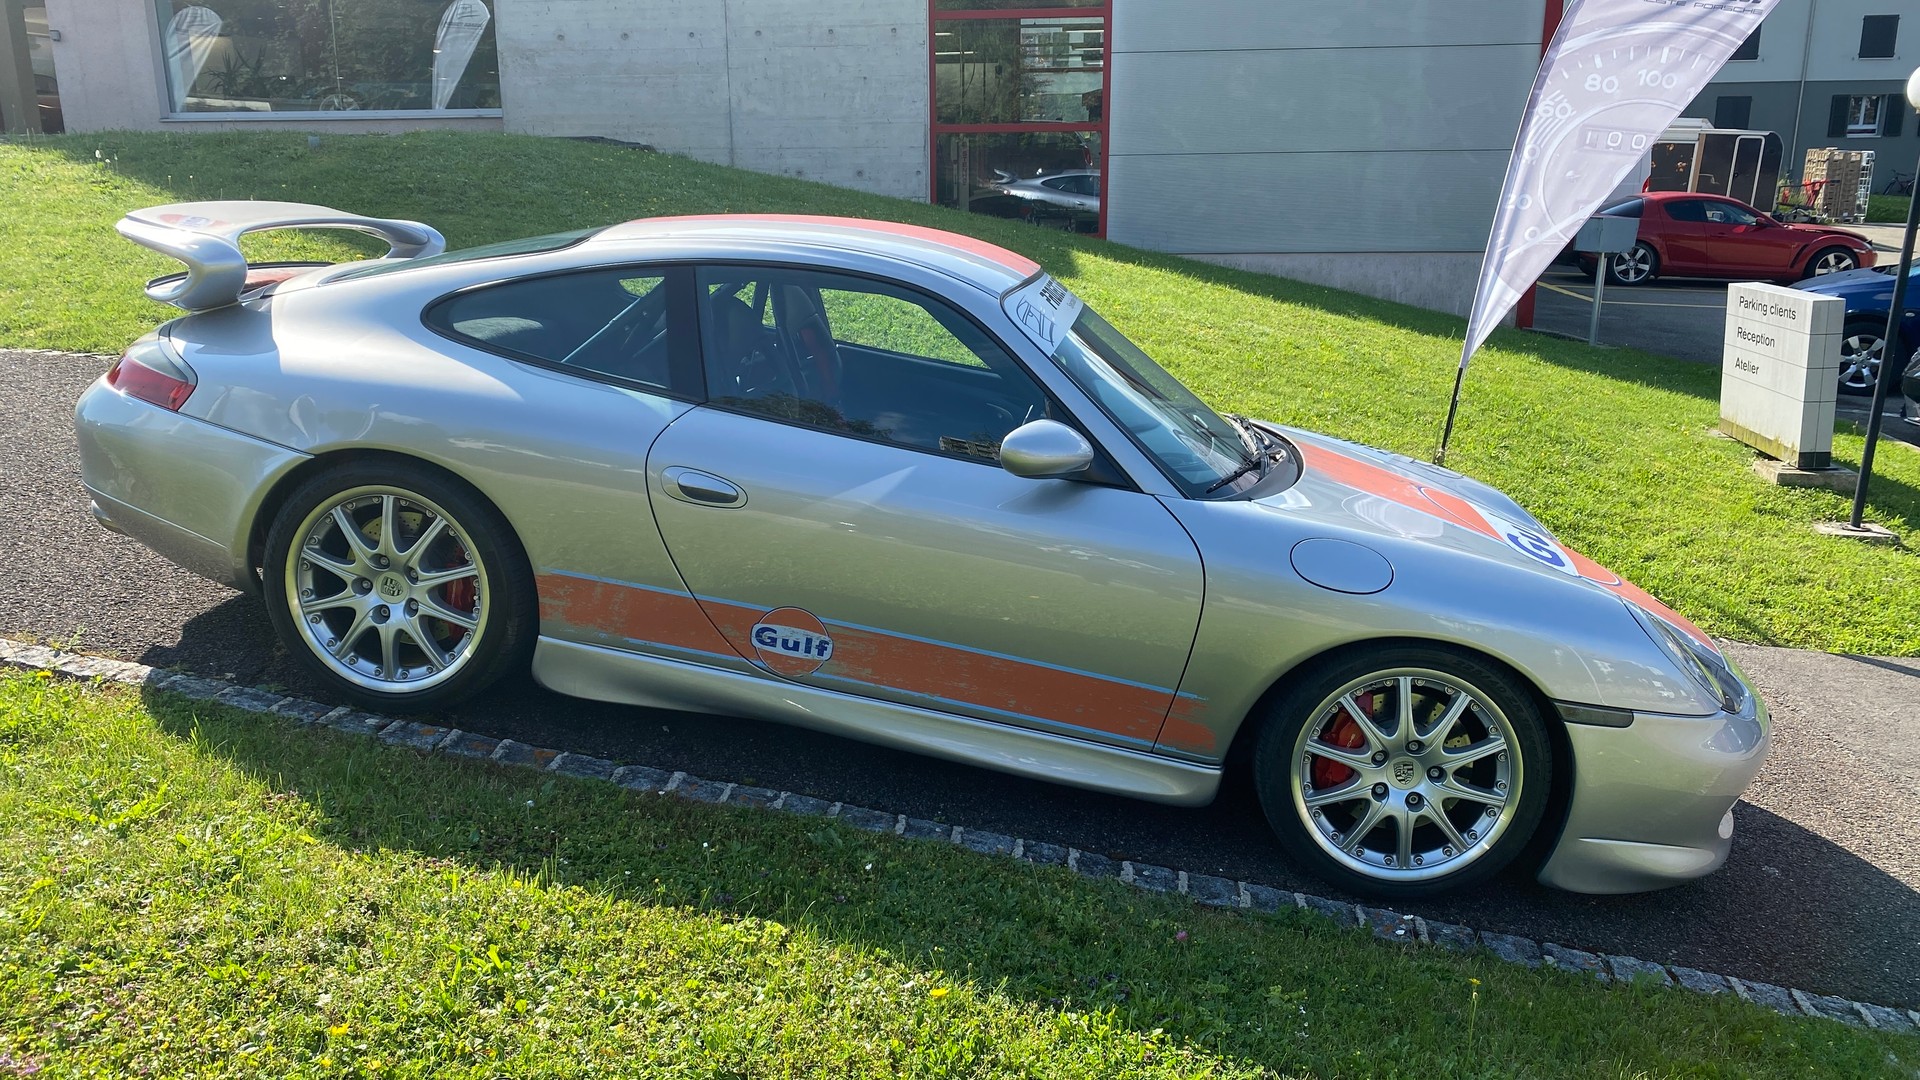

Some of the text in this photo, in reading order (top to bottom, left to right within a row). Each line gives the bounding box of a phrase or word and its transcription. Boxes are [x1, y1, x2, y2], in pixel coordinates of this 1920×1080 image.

[1693, 2, 1764, 15] PORSCHE
[1584, 73, 1619, 94] 80
[1637, 68, 1678, 89] 100
[1537, 100, 1572, 120] 60
[1739, 295, 1797, 320] Parking clients
[1736, 326, 1775, 348] Réception
[1734, 357, 1760, 375] Atelier
[754, 626, 830, 657] Gulf
